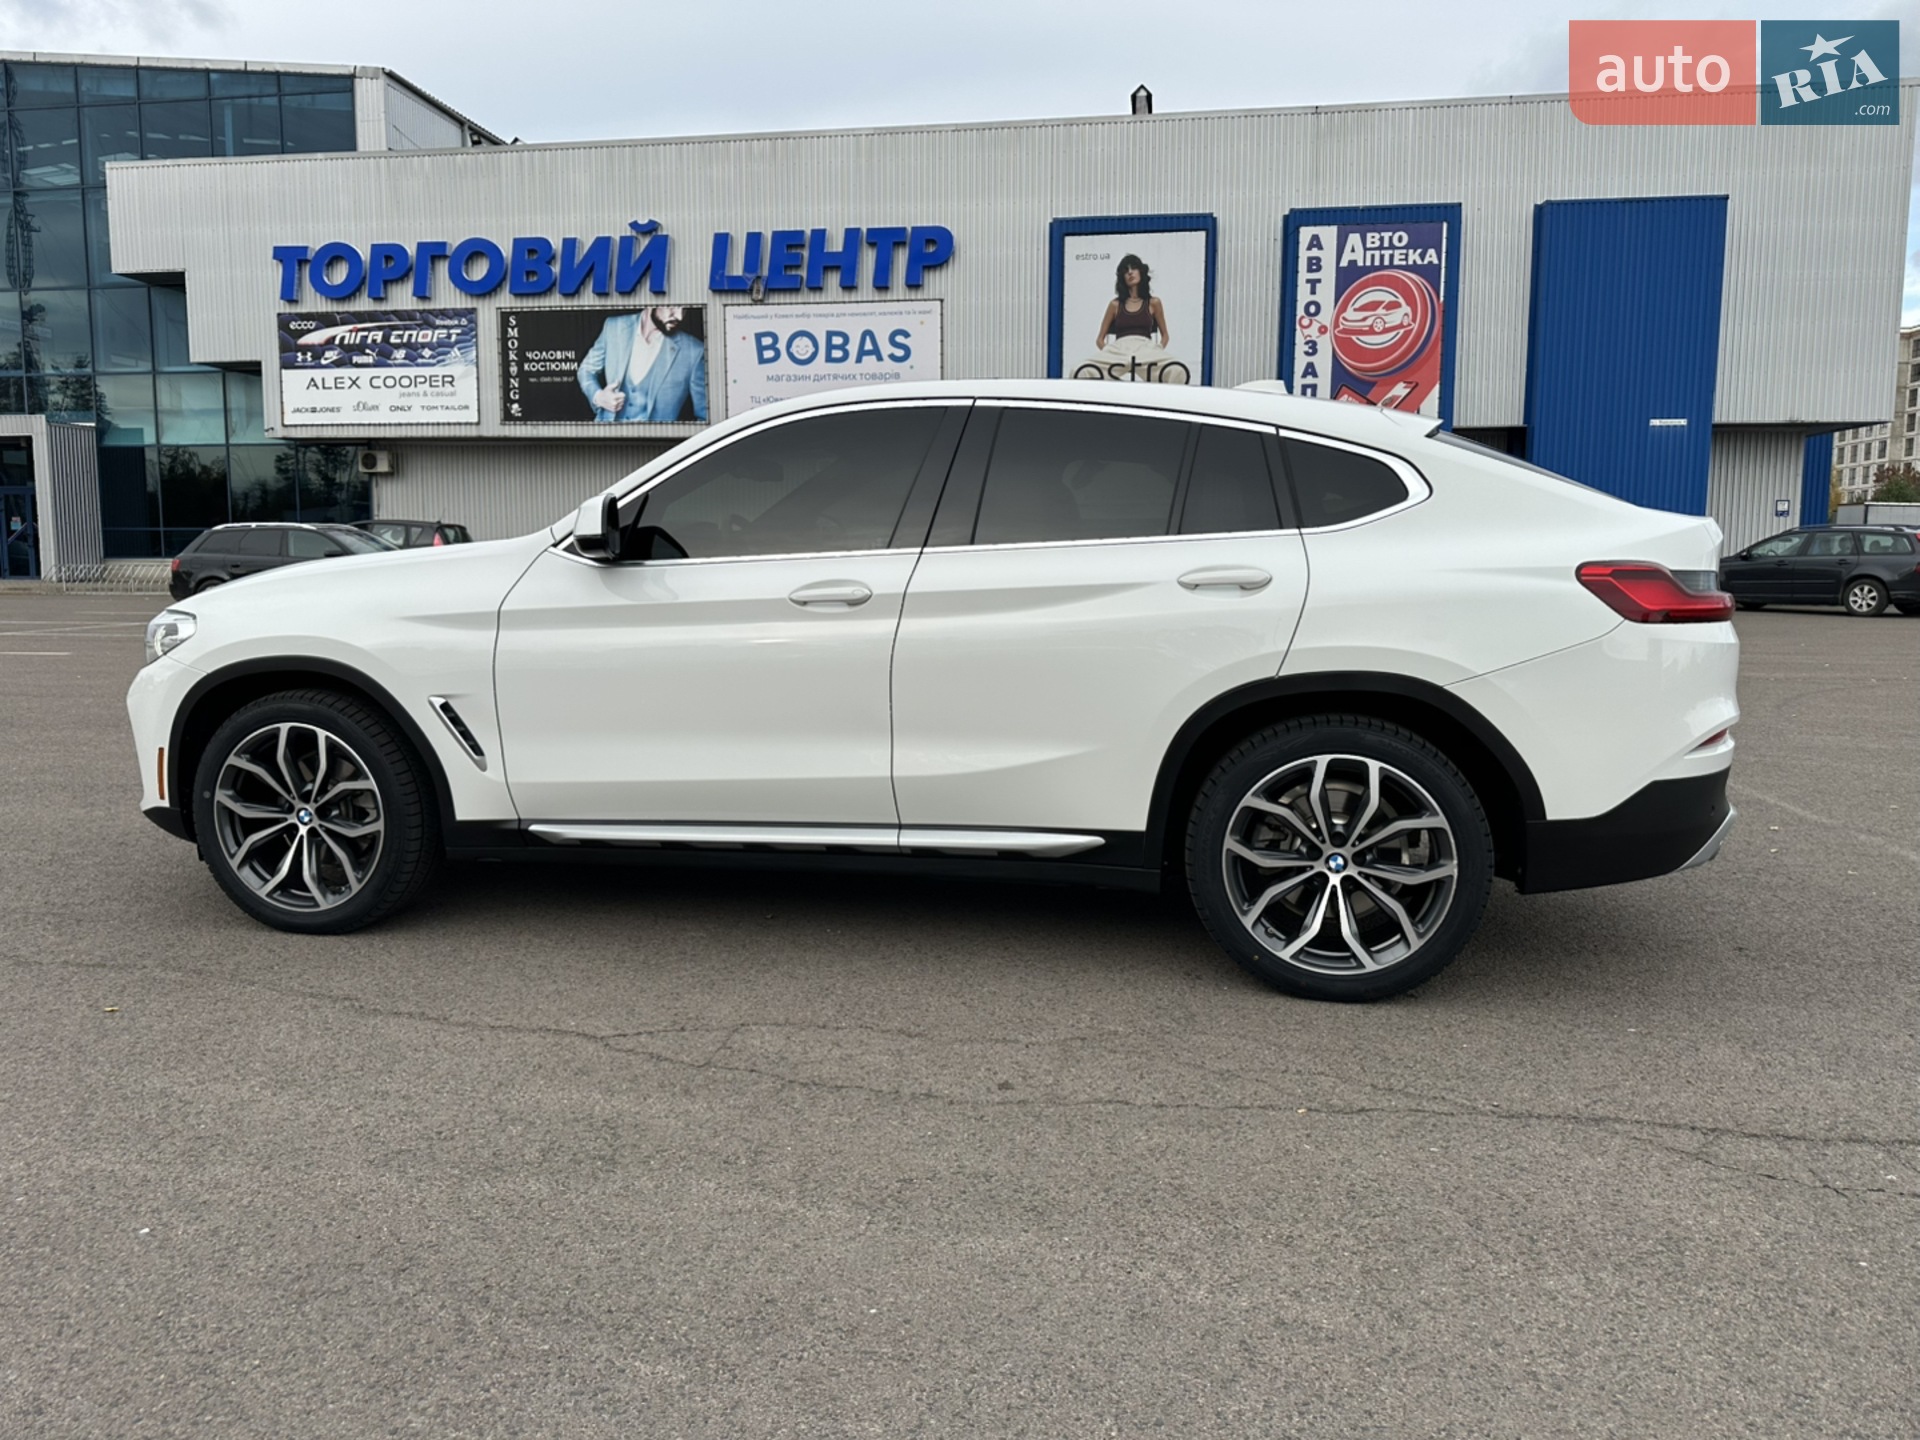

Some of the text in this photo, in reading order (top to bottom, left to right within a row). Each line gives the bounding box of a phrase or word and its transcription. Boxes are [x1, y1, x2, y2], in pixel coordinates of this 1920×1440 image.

[273, 219, 954, 302] ТОРГОВИЙ ЦЕНТР
[289, 320, 316, 330] ecco
[754, 328, 912, 366] BOBAS
[525, 350, 576, 360] ЧОЛОВІЧІ
[523, 361, 579, 372] КОСТЮМИ
[1073, 355, 1191, 385] estro
[766, 369, 900, 383] магазин дитячих товарів
[306, 375, 456, 390] ALEX COOPER
[399, 390, 457, 399] jeans & casual
[389, 404, 413, 412] ONLY
